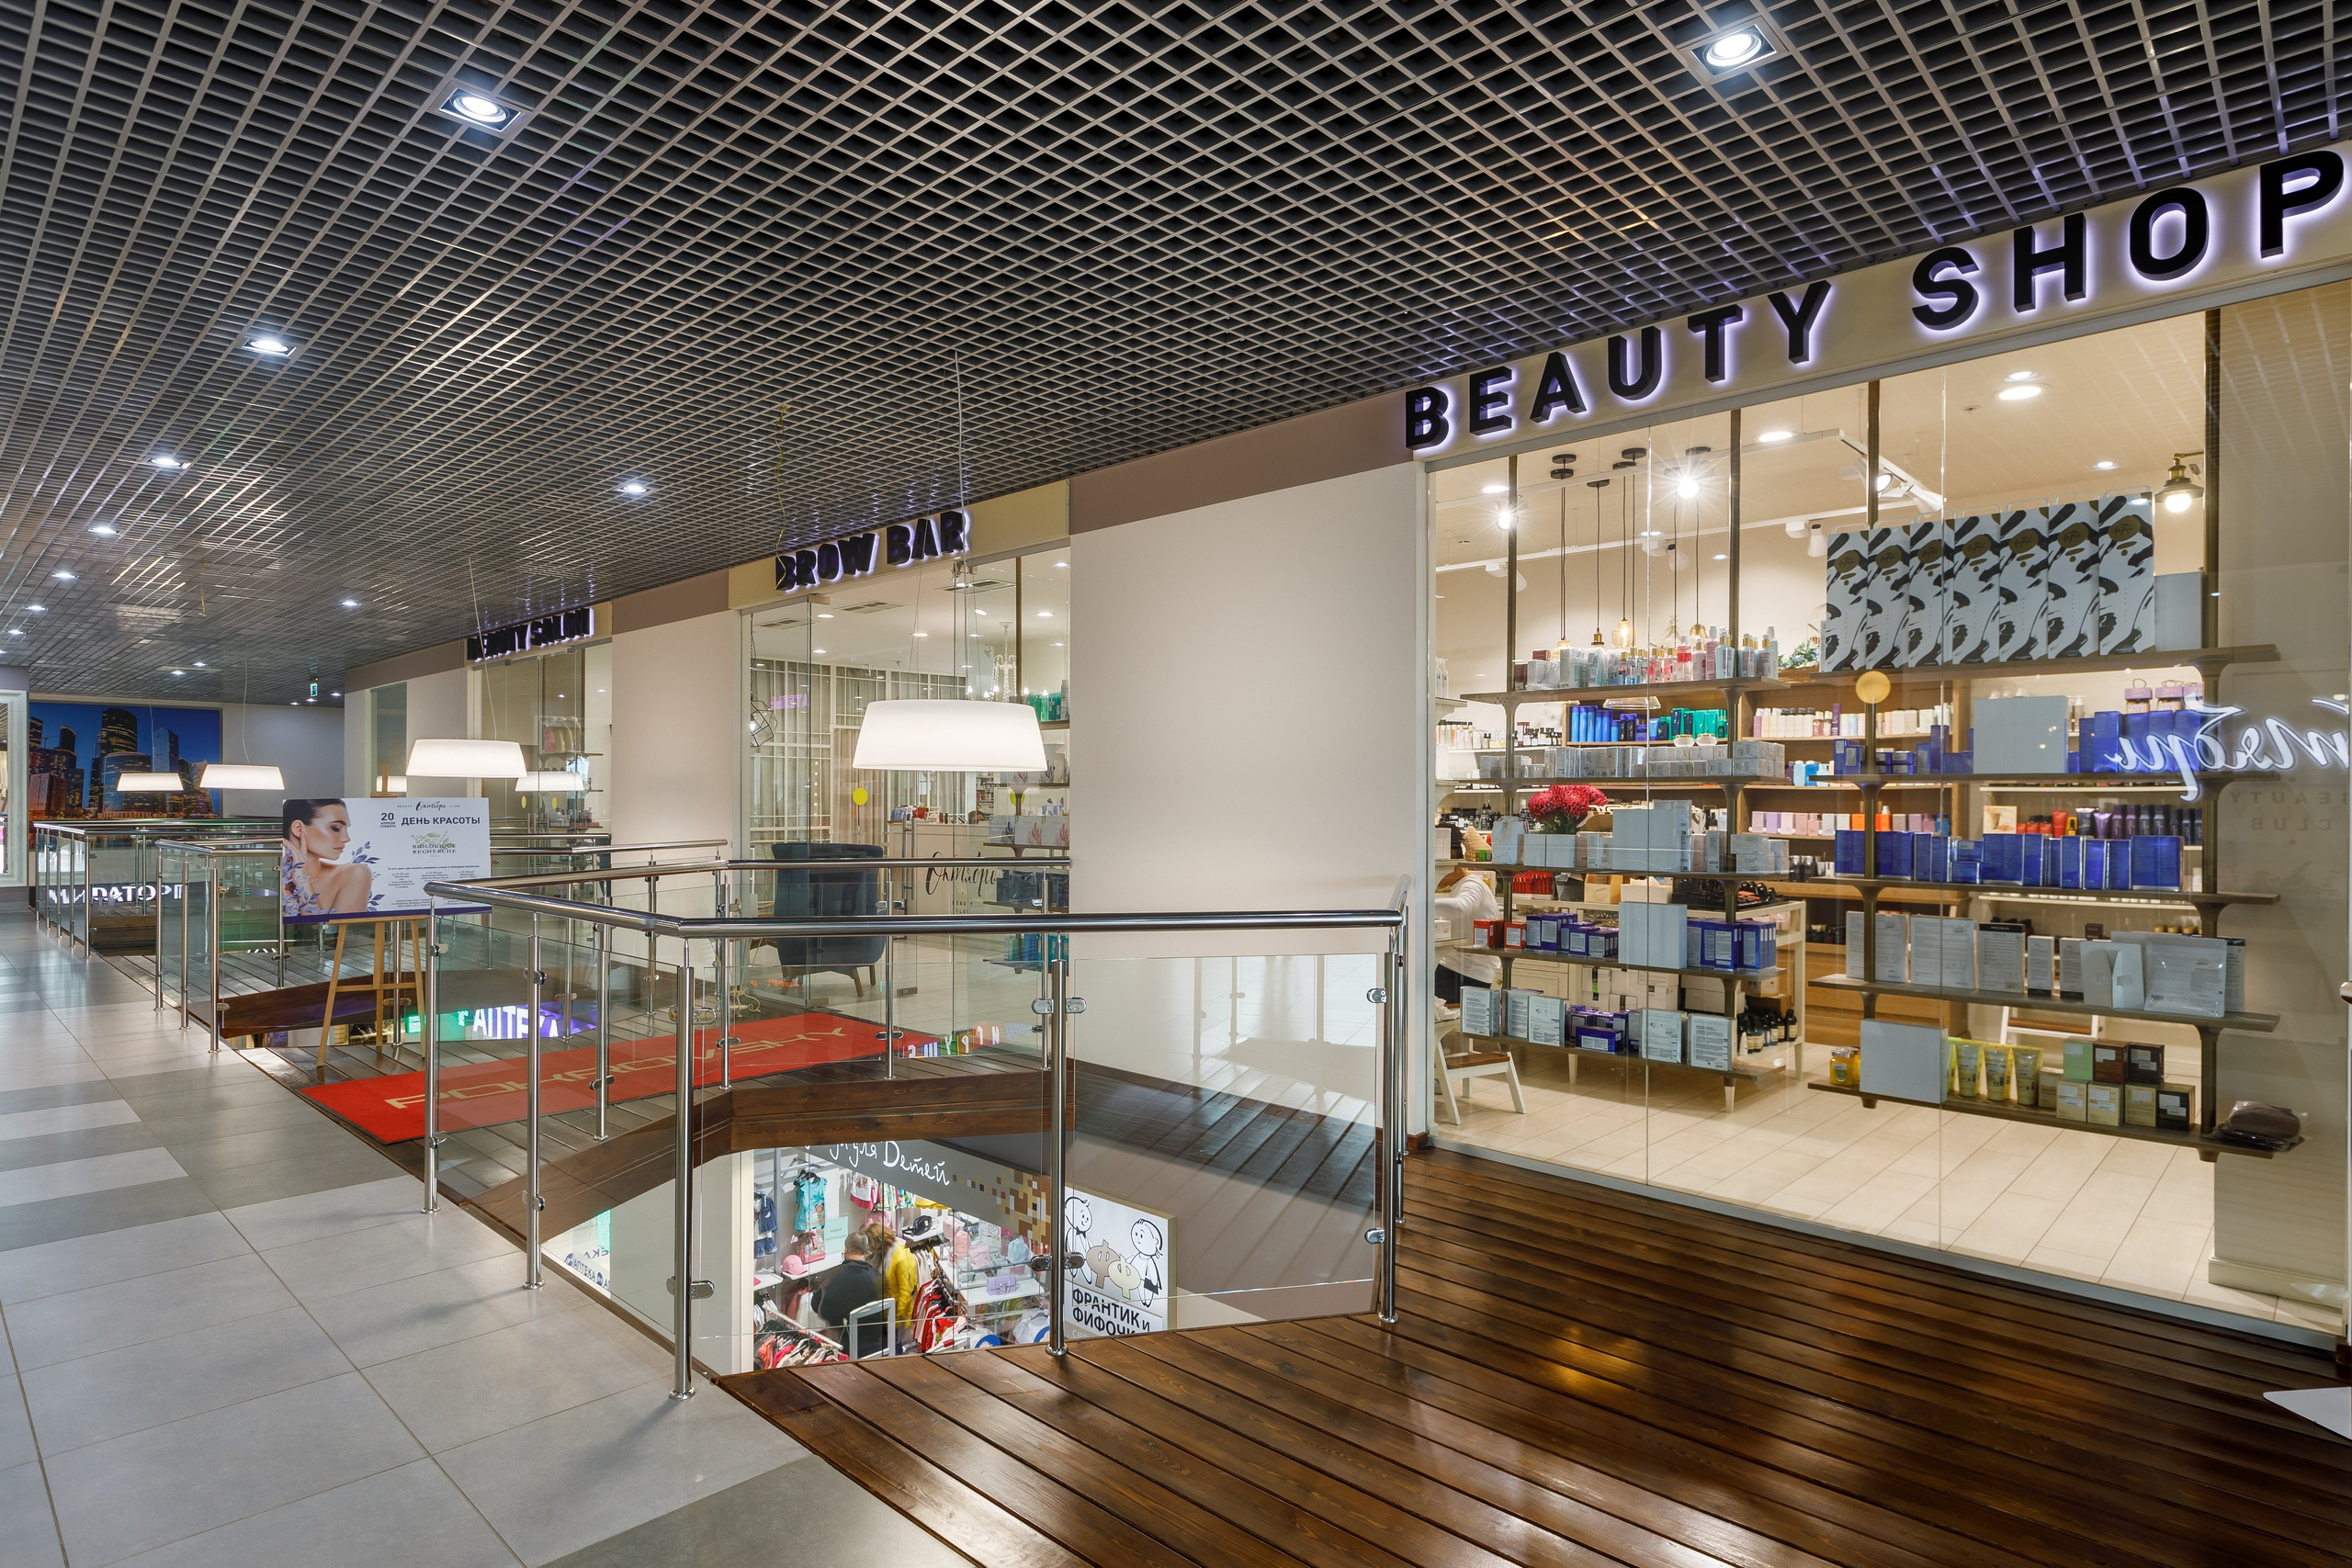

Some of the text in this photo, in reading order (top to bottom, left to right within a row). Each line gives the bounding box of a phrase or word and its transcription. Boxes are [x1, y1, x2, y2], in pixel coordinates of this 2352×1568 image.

[1405, 148, 2347, 450] BEAUTY SHOP
[775, 509, 971, 592] BROW BAR
[380, 812, 395, 821] 20
[401, 817, 481, 827] ДЕНЬ КРАСОТЫ
[883, 1140, 951, 1187] Детей
[1072, 1288, 1140, 1329] ФРАНТИК
[1072, 1306, 1136, 1336] ФИФОЧ
